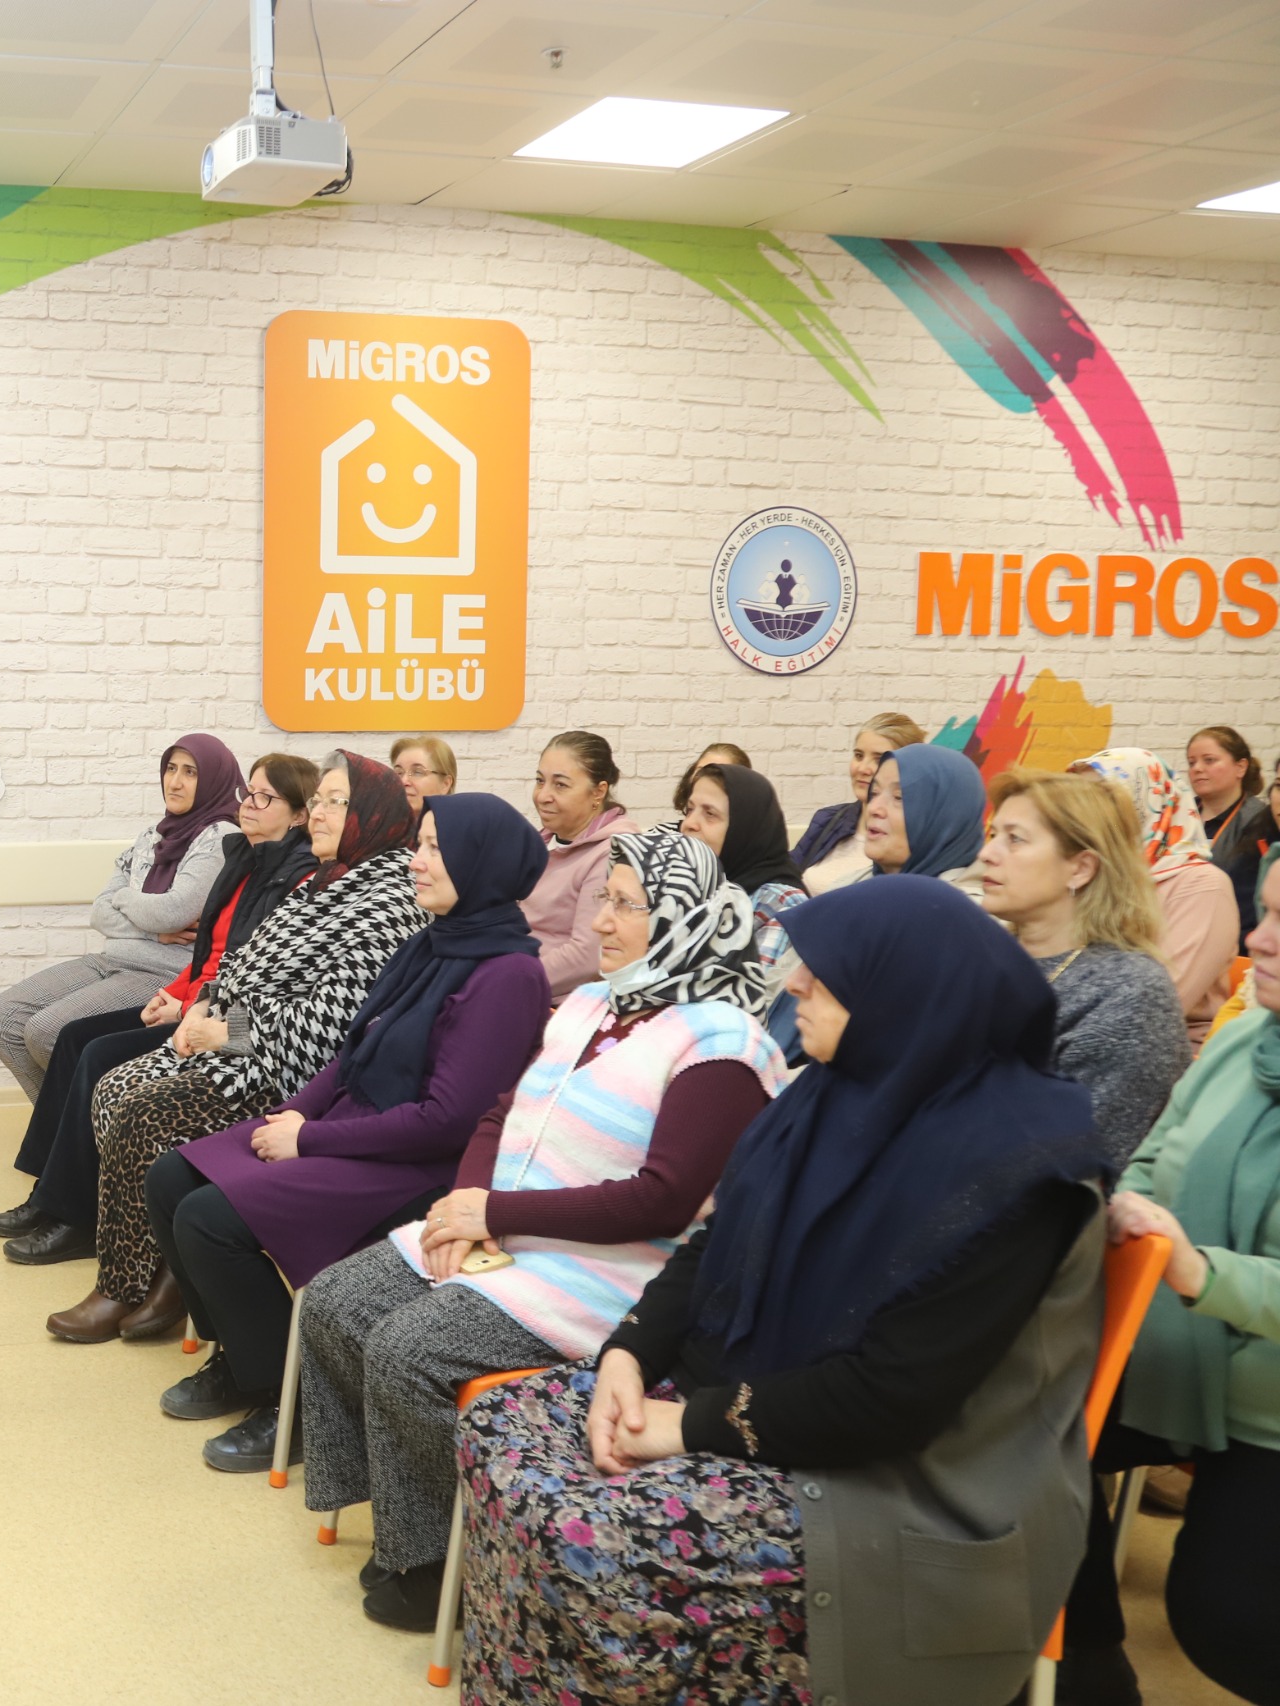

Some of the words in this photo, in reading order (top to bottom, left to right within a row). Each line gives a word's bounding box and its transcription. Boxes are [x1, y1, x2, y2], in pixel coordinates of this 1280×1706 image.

[739, 521, 760, 540] HER
[759, 512, 793, 526] YERDE
[800, 516, 836, 546] HERKES
[717, 543, 737, 583] ZAMAN
[833, 543, 848, 567] İÇİN
[716, 585, 726, 610] HER
[722, 624, 762, 667] HALK
[774, 626, 843, 672] EĞİTİMİ
[304, 658, 486, 701] KULÜBÜ
